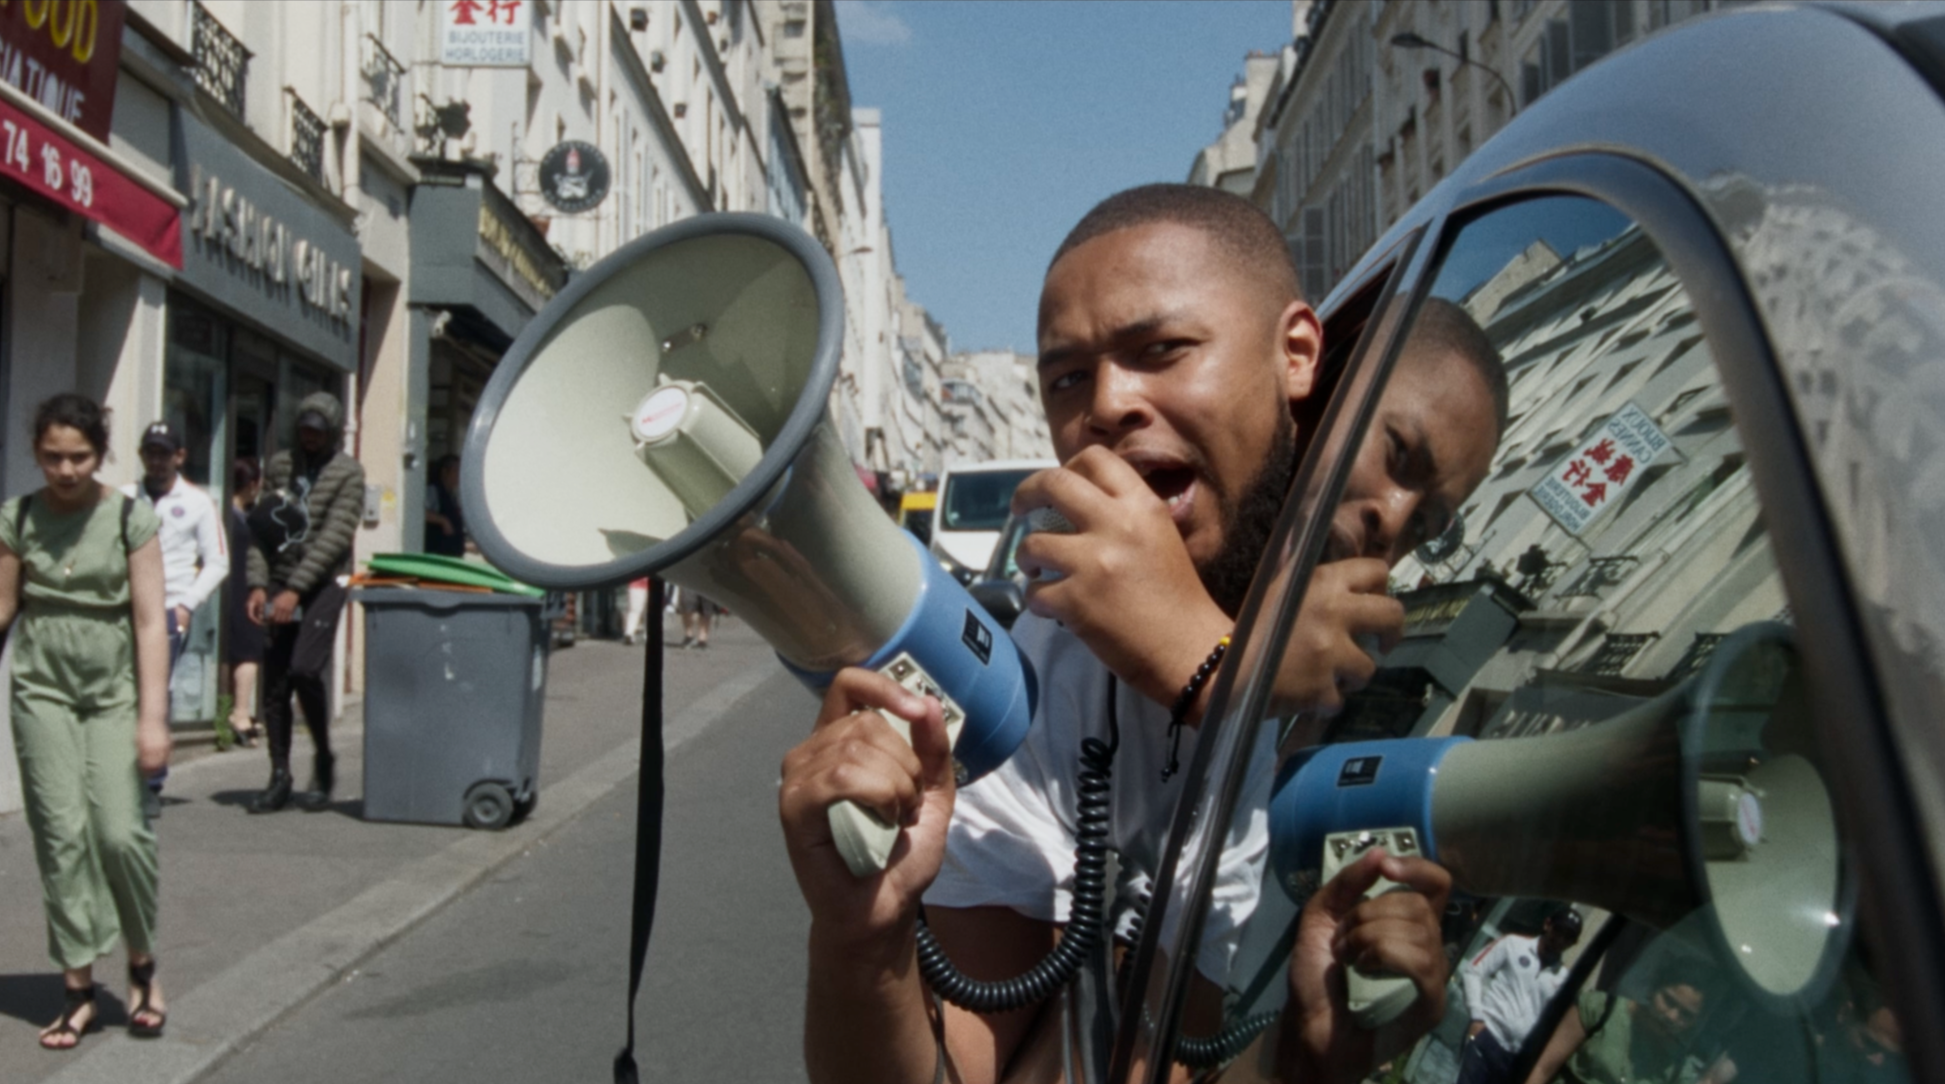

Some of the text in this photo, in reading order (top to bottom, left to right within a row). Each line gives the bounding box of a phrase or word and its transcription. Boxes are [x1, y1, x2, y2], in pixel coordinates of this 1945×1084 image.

[0, 0, 98, 63] OD
[445, 47, 525, 62] HORLOGERIE
[449, 30, 525, 44] BIJOUTERIE
[0, 36, 84, 122] IATIQUE
[3, 119, 93, 208] 74 16 99
